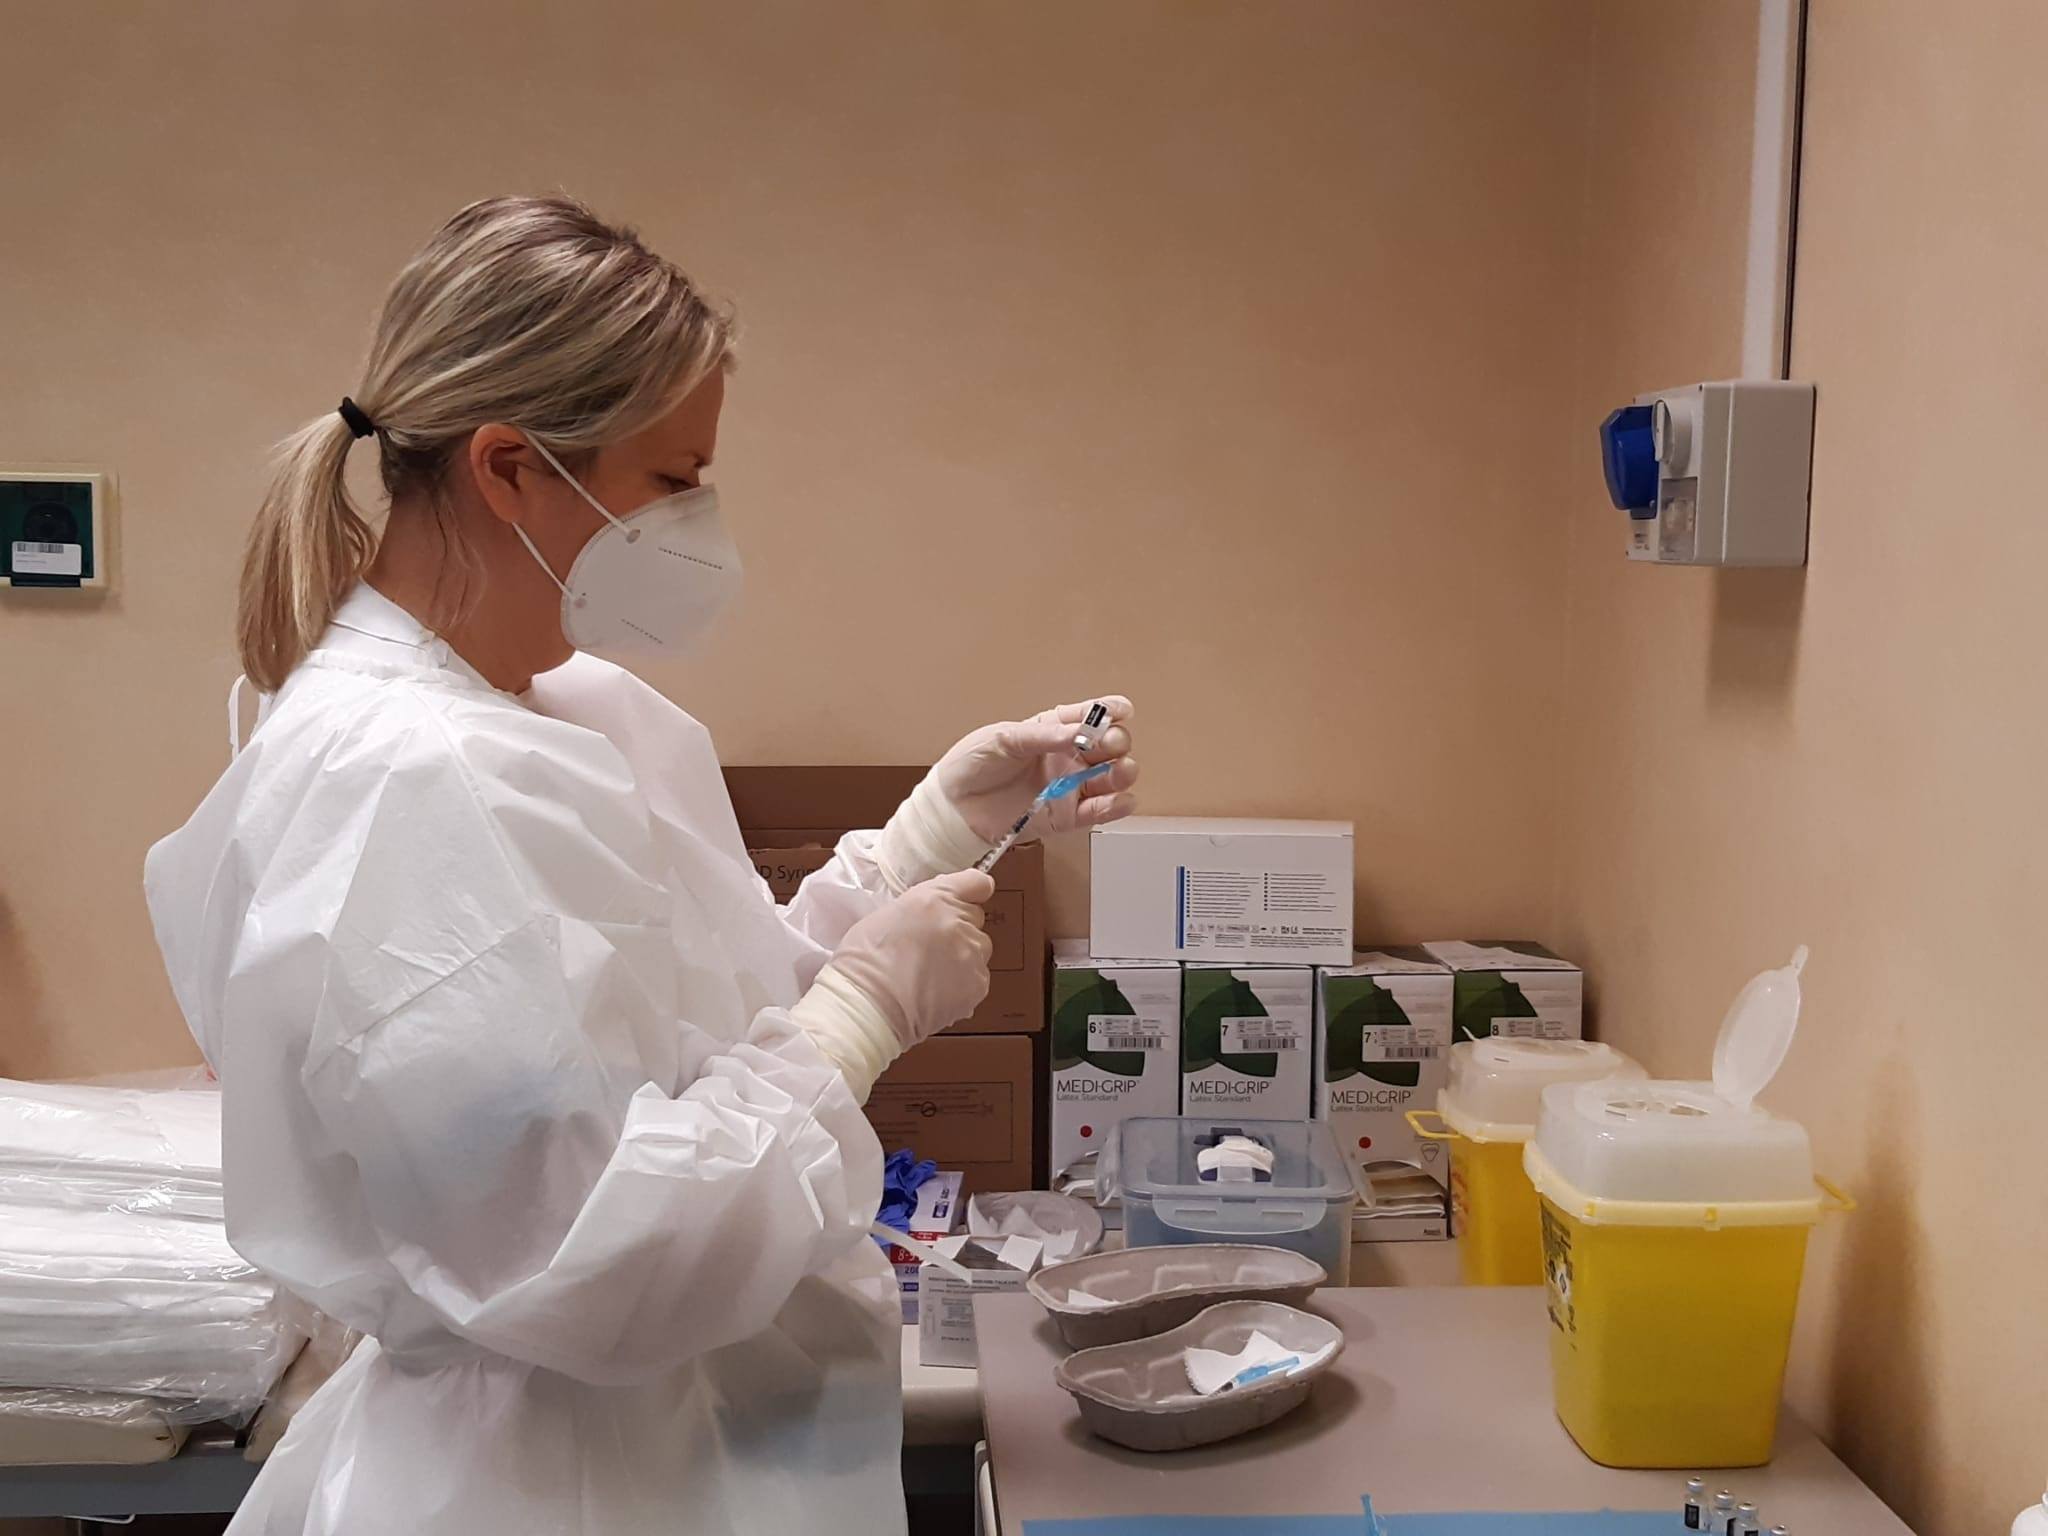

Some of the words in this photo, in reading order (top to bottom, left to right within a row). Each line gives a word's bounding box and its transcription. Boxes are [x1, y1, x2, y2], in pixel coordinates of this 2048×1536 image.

[1089, 1021, 1097, 1034] 6
[1222, 1024, 1229, 1036] 7
[1491, 1024, 1500, 1036] 8
[1364, 1031, 1372, 1043] 7
[1057, 1079, 1137, 1093] MEDI-GRIP
[1190, 1080, 1270, 1095] MEDI-GRIP
[1331, 1090, 1411, 1104] MEDI-GRIP
